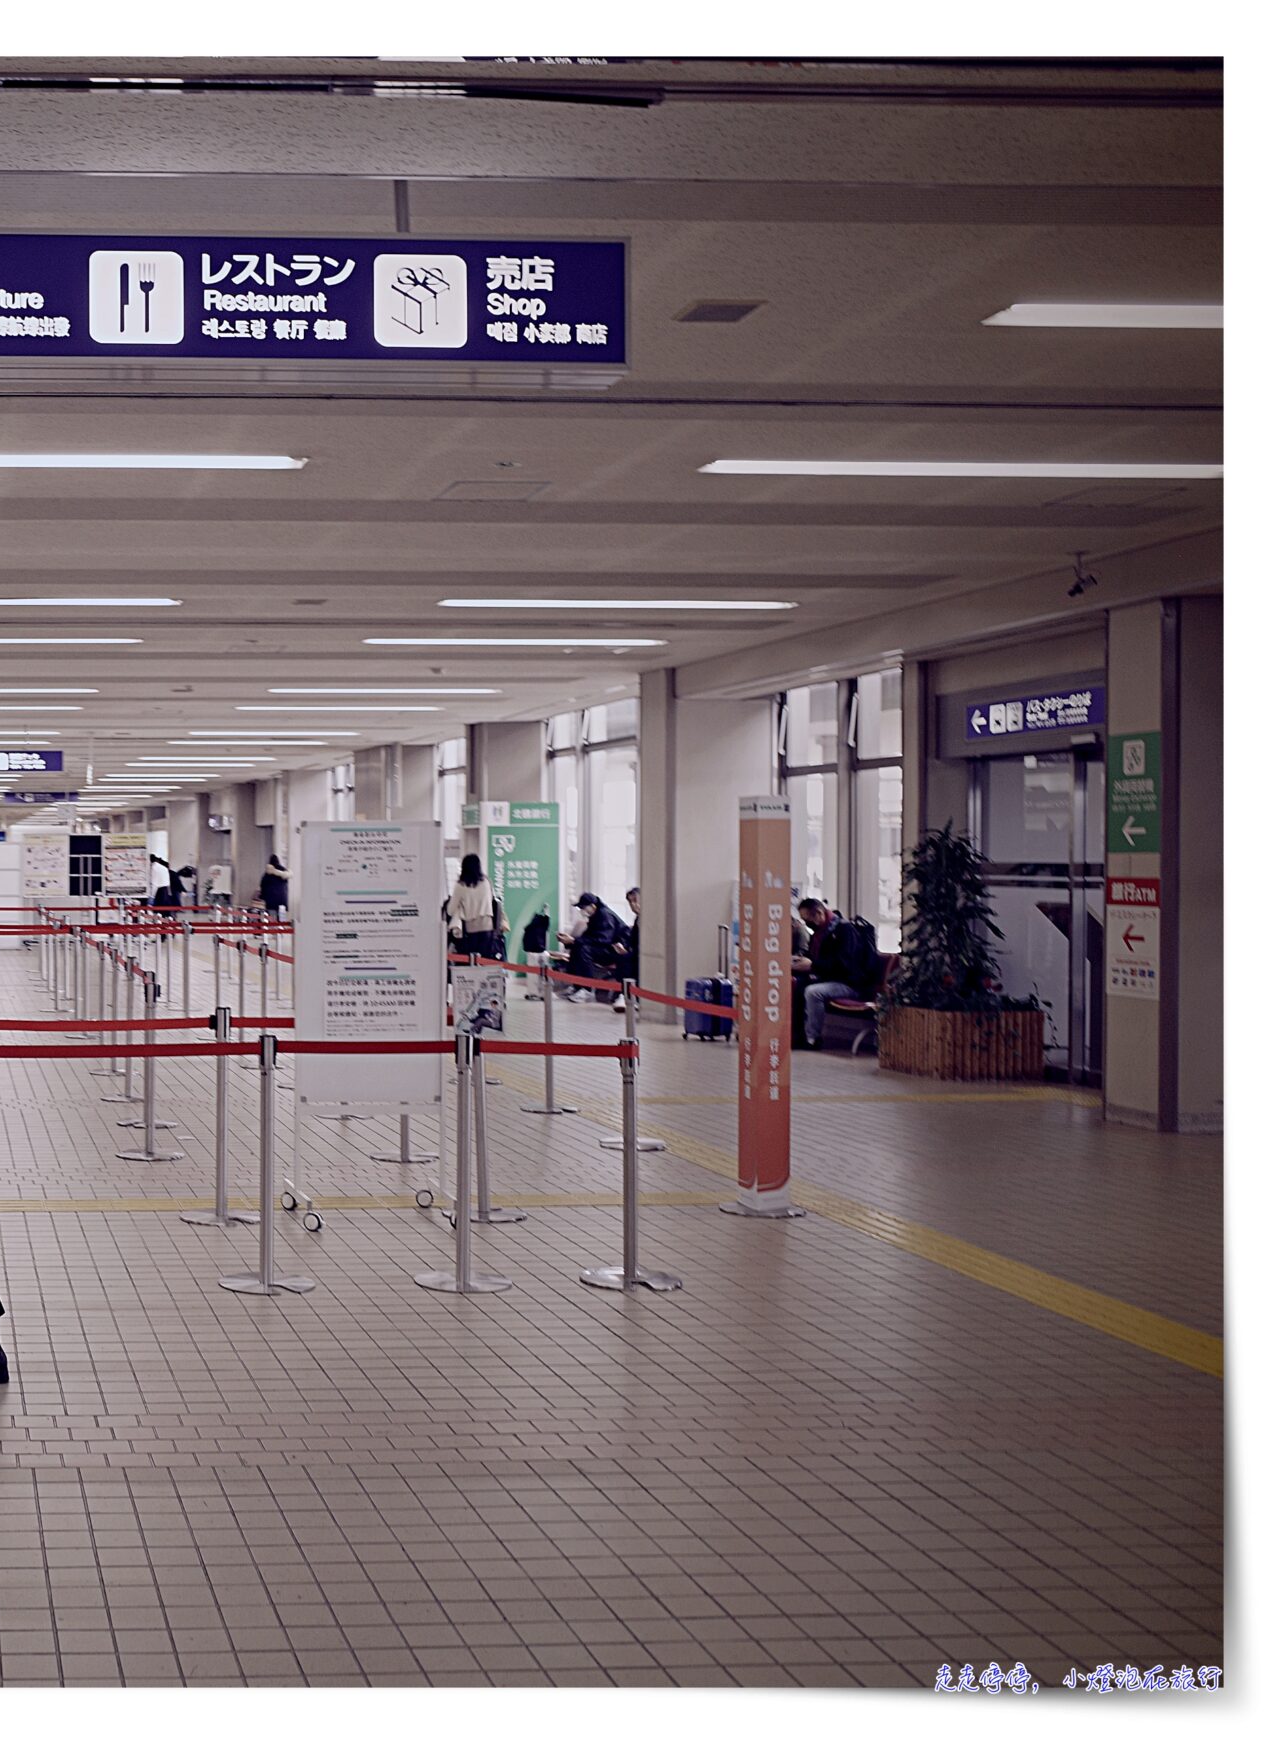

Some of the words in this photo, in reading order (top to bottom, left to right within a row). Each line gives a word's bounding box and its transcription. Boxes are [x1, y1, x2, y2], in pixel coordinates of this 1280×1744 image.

[201, 253, 356, 287] レストラン
[485, 255, 555, 292] 売店
[203, 289, 328, 313] Restaurant
[486, 294, 547, 319] Shop
[201, 317, 268, 340] 레스토랑
[741, 903, 753, 952] Bag
[764, 904, 783, 953] Bag
[741, 959, 754, 1022] drop
[764, 959, 784, 1023] drop
